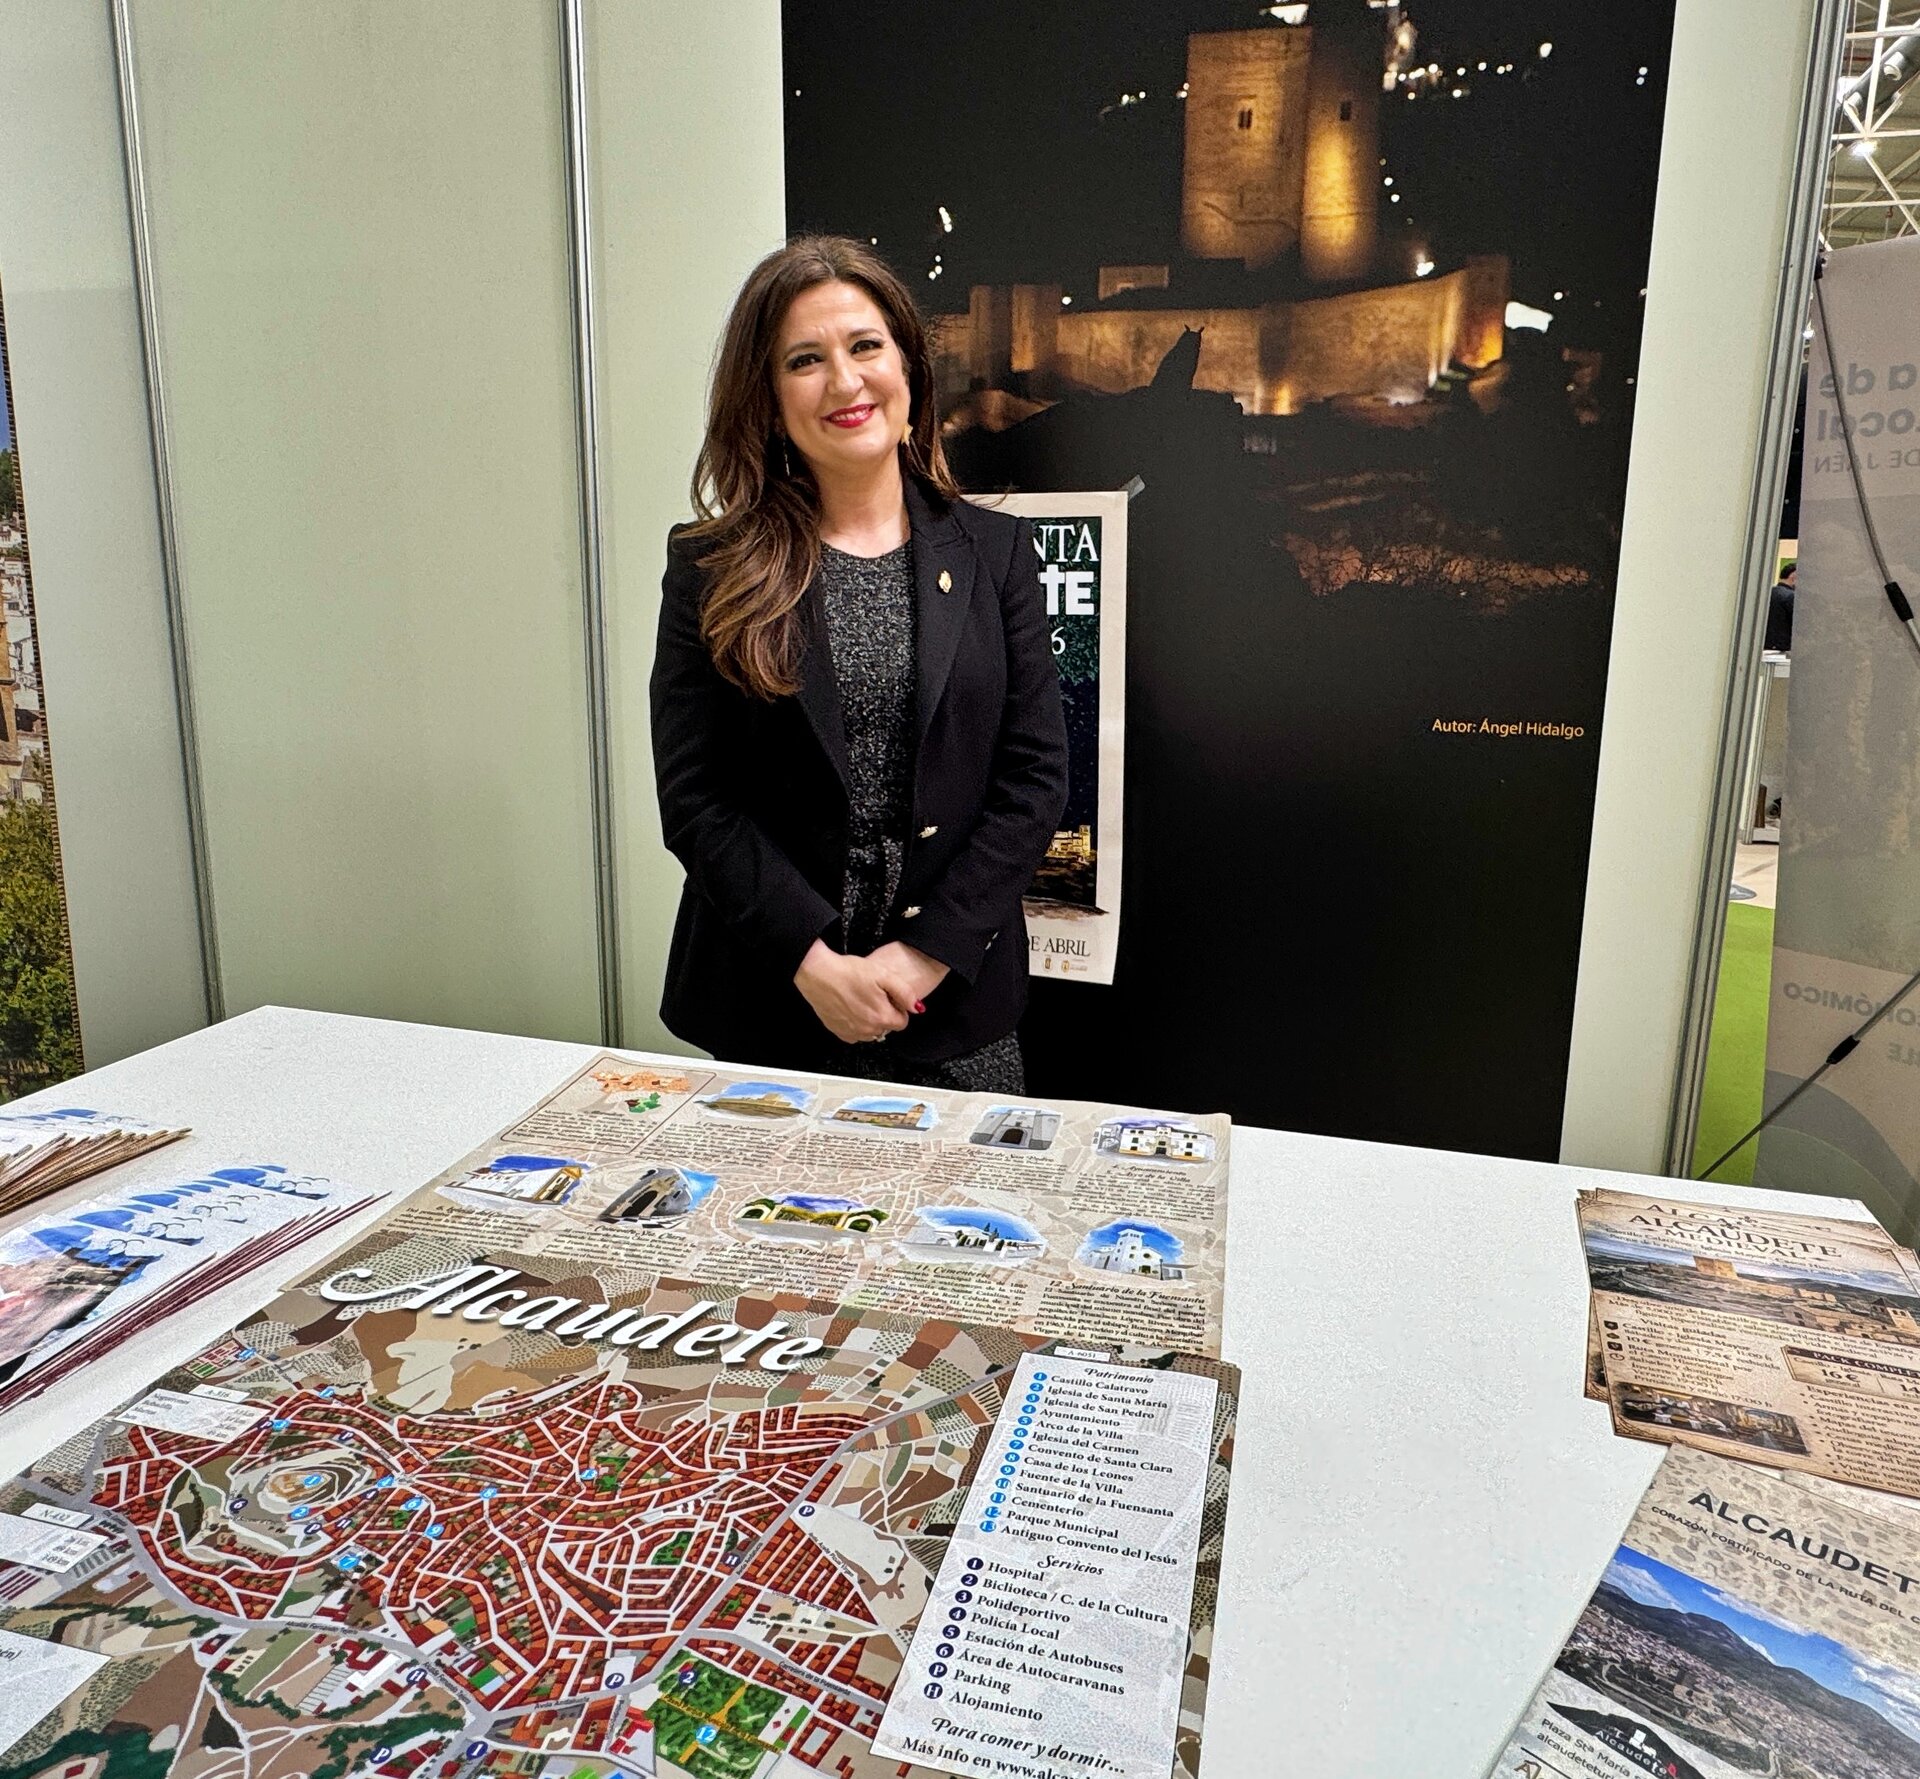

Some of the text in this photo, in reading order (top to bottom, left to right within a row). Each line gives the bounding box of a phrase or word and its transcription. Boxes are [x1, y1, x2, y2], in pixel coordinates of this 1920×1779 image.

[1432, 718, 1584, 740] Autor: Ángel Hidalgo
[1029, 936, 1090, 957] E ABRIL
[1629, 1215, 1842, 1258] ALCAUDETE
[1665, 1229, 1806, 1260] MEDIEVAL
[933, 1266, 991, 1278] Cementerio
[1066, 1283, 1119, 1294] Santuario
[1147, 1290, 1205, 1304] Fuensanta
[320, 1265, 825, 1373] Alcaudete
[1813, 1352, 1852, 1364] PACK
[1051, 1375, 1093, 1387] Castillo
[1084, 1367, 1154, 1384] Patrimonio
[1822, 1369, 1861, 1382] 16 €
[1043, 1397, 1079, 1411] Iglesia
[1081, 1402, 1095, 1411] de
[1097, 1405, 1118, 1415] San
[1122, 1408, 1155, 1419] Pedro
[1048, 1386, 1083, 1399] Iglesia
[1085, 1391, 1099, 1399] de
[1101, 1394, 1131, 1405] Santa
[1134, 1396, 1168, 1408] María
[1036, 1420, 1063, 1431] Arco
[1066, 1424, 1081, 1434] de
[1083, 1427, 1093, 1436] la
[1096, 1429, 1123, 1440] Villa
[1039, 1408, 1121, 1427] Ayuntamiento
[1032, 1431, 1069, 1446] Iglesia
[1072, 1437, 1090, 1448] del
[1092, 1442, 1139, 1456] Carmen
[1024, 1456, 1052, 1469] Casa
[1055, 1460, 1069, 1471] de
[1072, 1464, 1089, 1474] los
[1092, 1468, 1134, 1482] Leones
[1028, 1444, 1084, 1461] Convento
[1087, 1452, 1102, 1463] de
[1103, 1456, 1137, 1469] Santa
[1140, 1462, 1173, 1474] Clara
[1019, 1469, 1061, 1484] Fuente
[1062, 1475, 1078, 1486] de
[1081, 1479, 1091, 1489] la
[1094, 1482, 1123, 1495] Villa
[1012, 1497, 1084, 1517] Cementerio
[1015, 1482, 1075, 1500] Santuario
[1078, 1491, 1094, 1502] de
[1096, 1496, 1107, 1505] la
[1110, 1499, 1174, 1518] Fuensanta
[1006, 1510, 1051, 1526] Parque
[1053, 1519, 1119, 1539] Municipal
[1001, 1524, 1054, 1543] Antiguo
[1057, 1536, 1118, 1554] Convento
[1122, 1546, 1142, 1559] del
[1145, 1550, 1178, 1565] Jesús
[1688, 1492, 1920, 1594] ALCAUDET
[988, 1562, 1045, 1583] Hospital
[1037, 1555, 1104, 1576] Servicios
[1651, 1505, 1709, 1536] CORAZÓN
[1711, 1533, 1792, 1571] FORTIFICADO
[1796, 1568, 1813, 1579] DE
[1817, 1576, 1835, 1590] LA
[1839, 1585, 1876, 1606] RUTA
[1879, 1602, 1906, 1618] DEL
[977, 1595, 1071, 1624] Polideportivo
[983, 1578, 1048, 1602] Biclioteca
[1060, 1593, 1075, 1605] C.
[1079, 1598, 1096, 1609] de
[1098, 1600, 1110, 1611] la
[1115, 1603, 1169, 1624] Cultura
[971, 1612, 1019, 1633] Policía
[1022, 1624, 1060, 1641] Local
[963, 1630, 1024, 1652] Estación
[1028, 1643, 1045, 1657] de
[1048, 1648, 1124, 1674] Autobuses
[953, 1669, 1012, 1695] Parking
[956, 1648, 992, 1669] Área
[996, 1656, 1013, 1670] de
[1016, 1661, 1125, 1695] Autocaravanas
[949, 1690, 1043, 1722] Alojamiento
[902, 1737, 934, 1755] Más
[938, 1743, 969, 1763] info
[973, 1756, 992, 1769] en
[931, 1717, 1125, 1774] Para comer y dormir...
[1542, 1719, 1572, 1741] Plaza
[1597, 1752, 1630, 1777] María
[1595, 1730, 1668, 1777] Alcaudete
